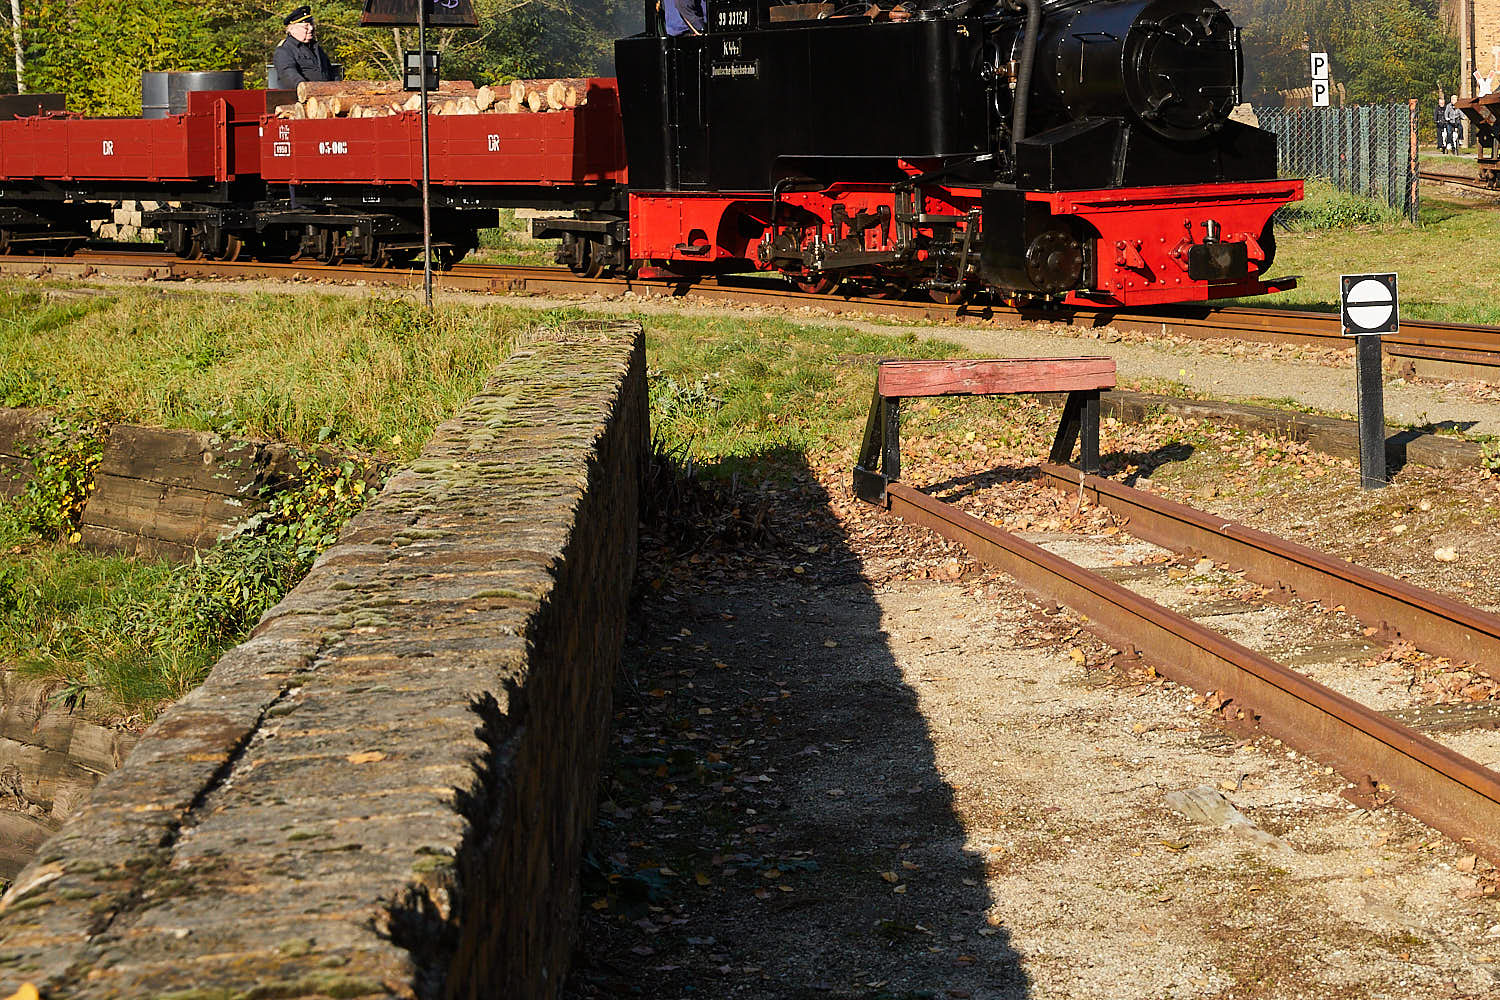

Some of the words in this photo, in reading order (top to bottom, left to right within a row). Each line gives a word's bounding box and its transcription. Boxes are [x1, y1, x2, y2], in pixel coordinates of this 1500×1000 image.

[1314, 57, 1325, 76] P
[1315, 84, 1326, 103] P
[103, 140, 114, 156] DR
[487, 134, 500, 152] DR
